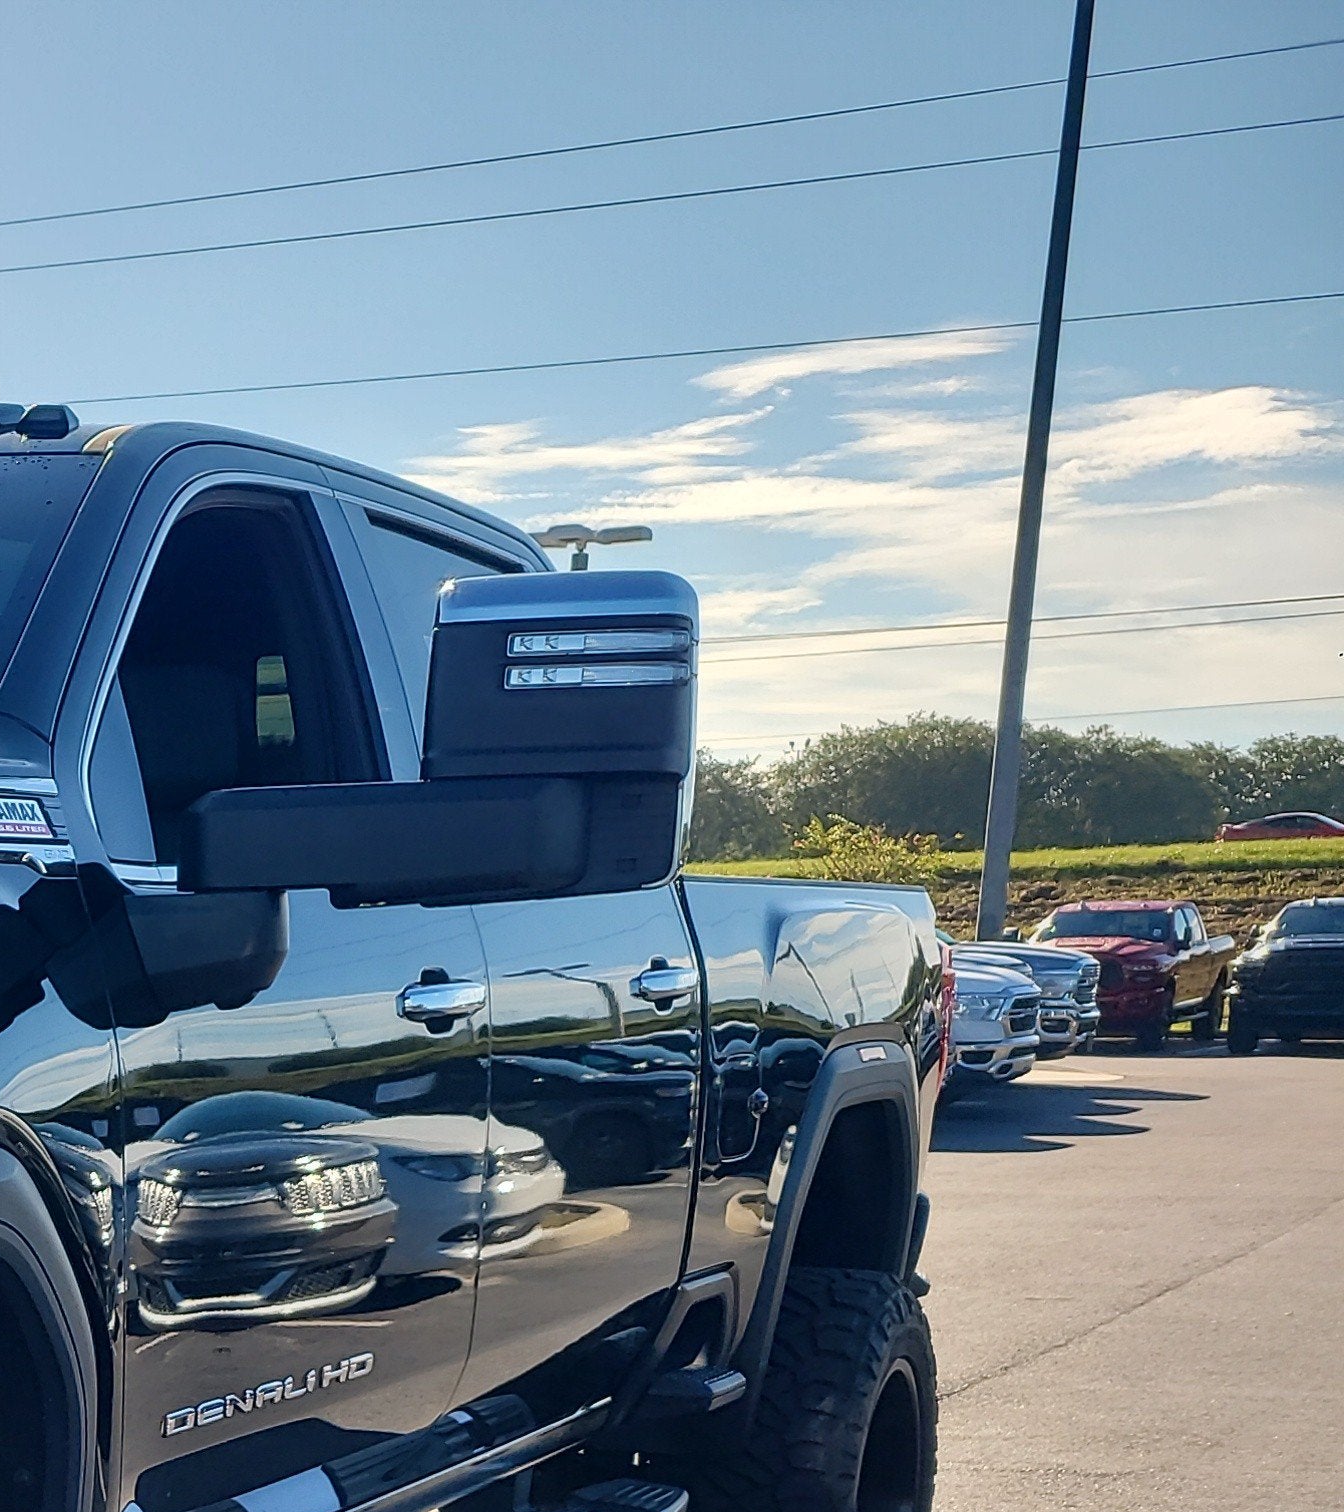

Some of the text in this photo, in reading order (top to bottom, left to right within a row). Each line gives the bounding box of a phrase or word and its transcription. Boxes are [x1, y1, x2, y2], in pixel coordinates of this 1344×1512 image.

[15, 823, 46, 833] LITER
[160, 1351, 375, 1438] DENALI HD
